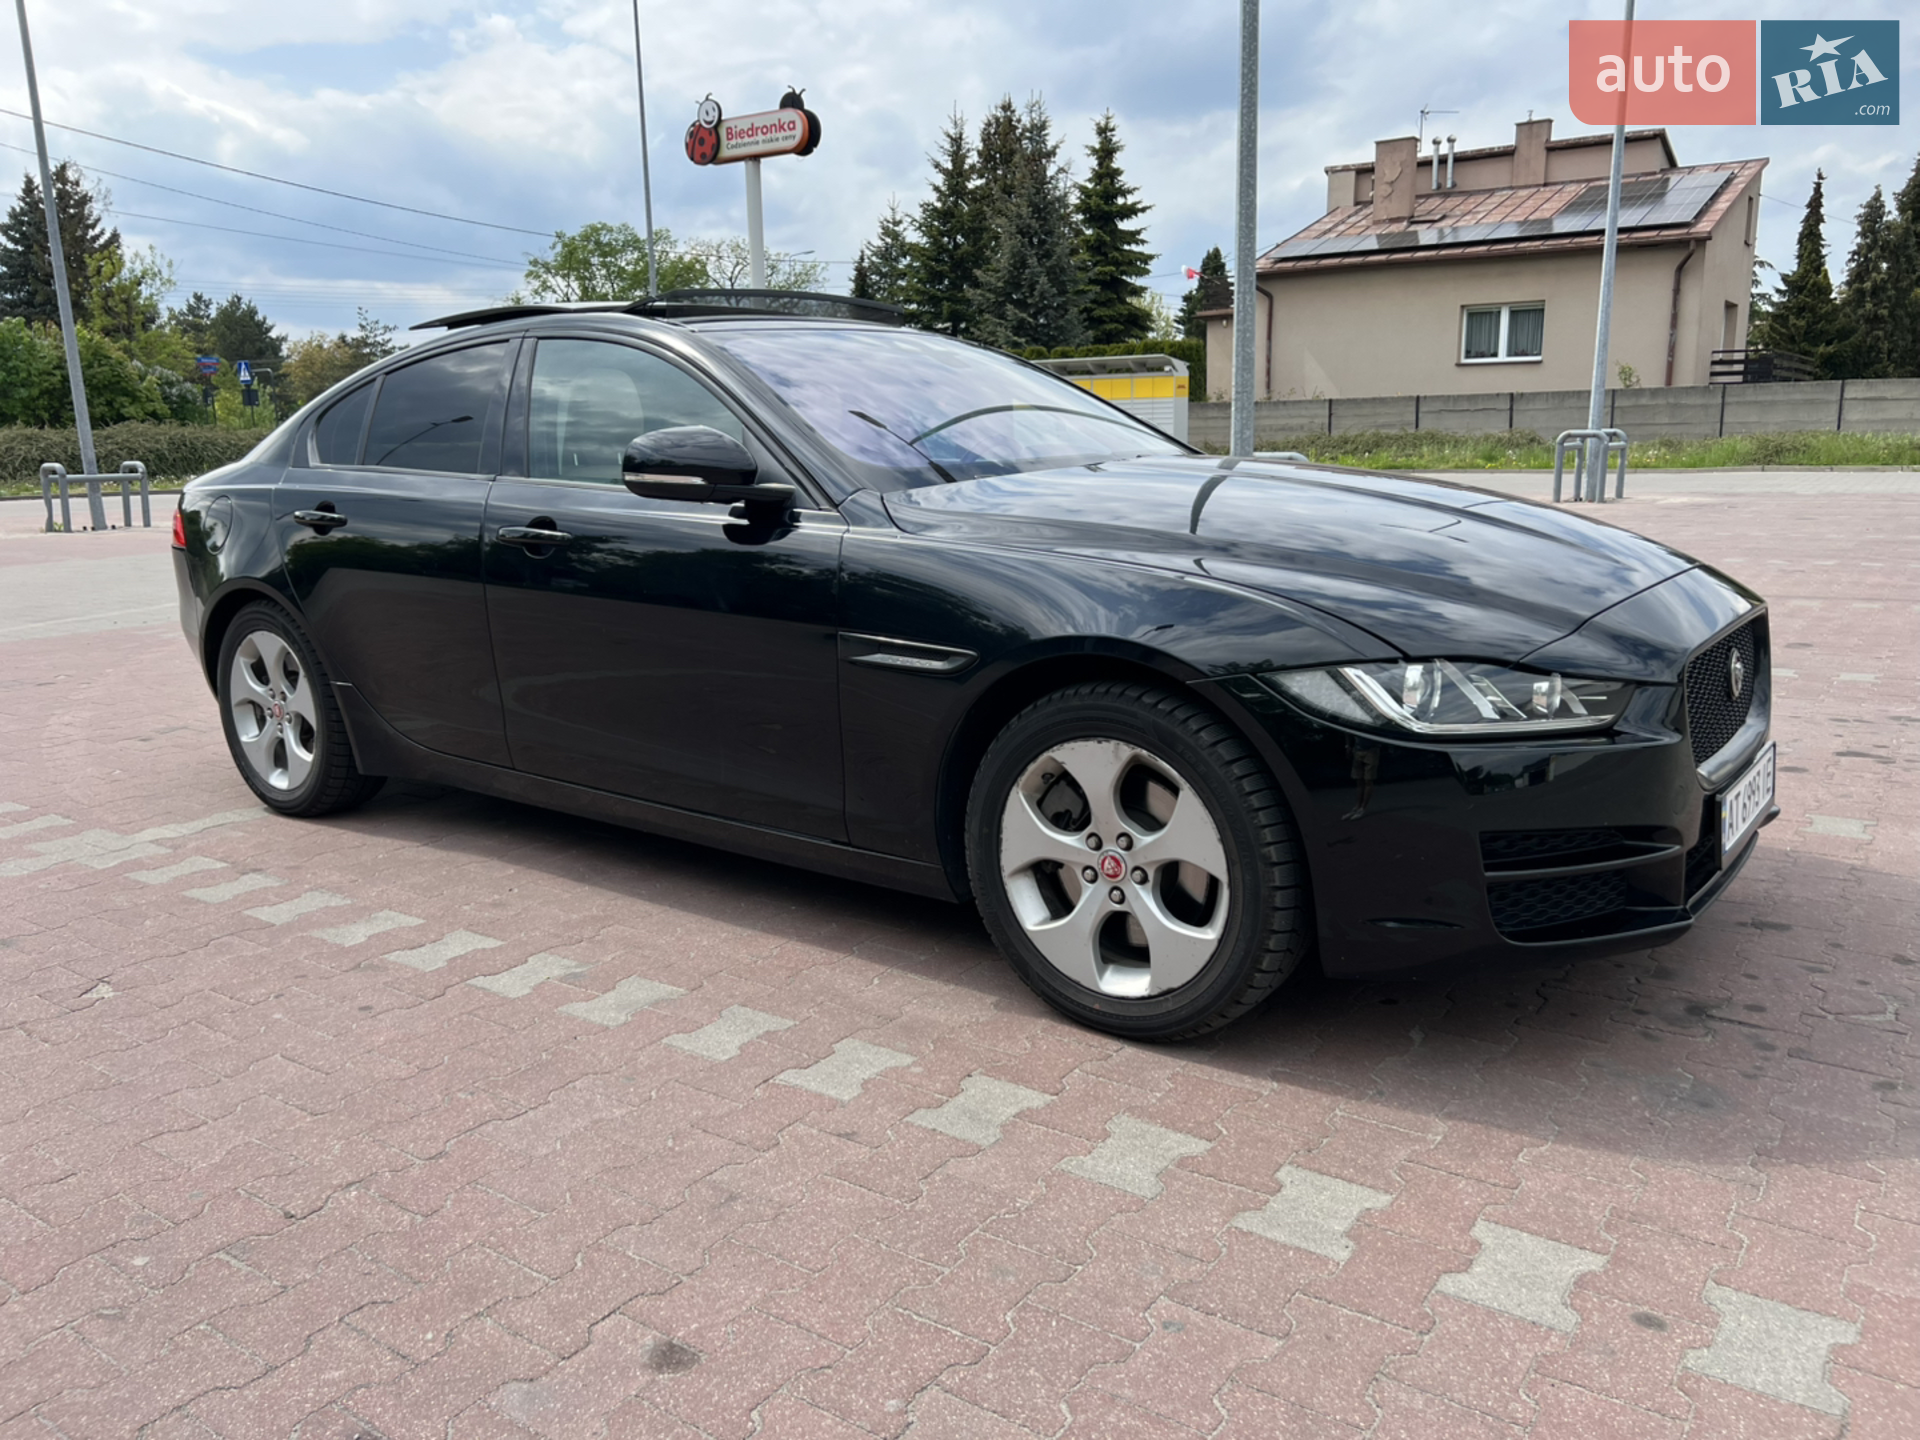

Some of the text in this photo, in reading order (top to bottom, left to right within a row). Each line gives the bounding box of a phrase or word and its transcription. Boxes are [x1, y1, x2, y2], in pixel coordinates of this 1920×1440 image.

[726, 119, 796, 141] Biedronka
[726, 139, 760, 150] Codziennie
[1727, 790, 1741, 841] AT
